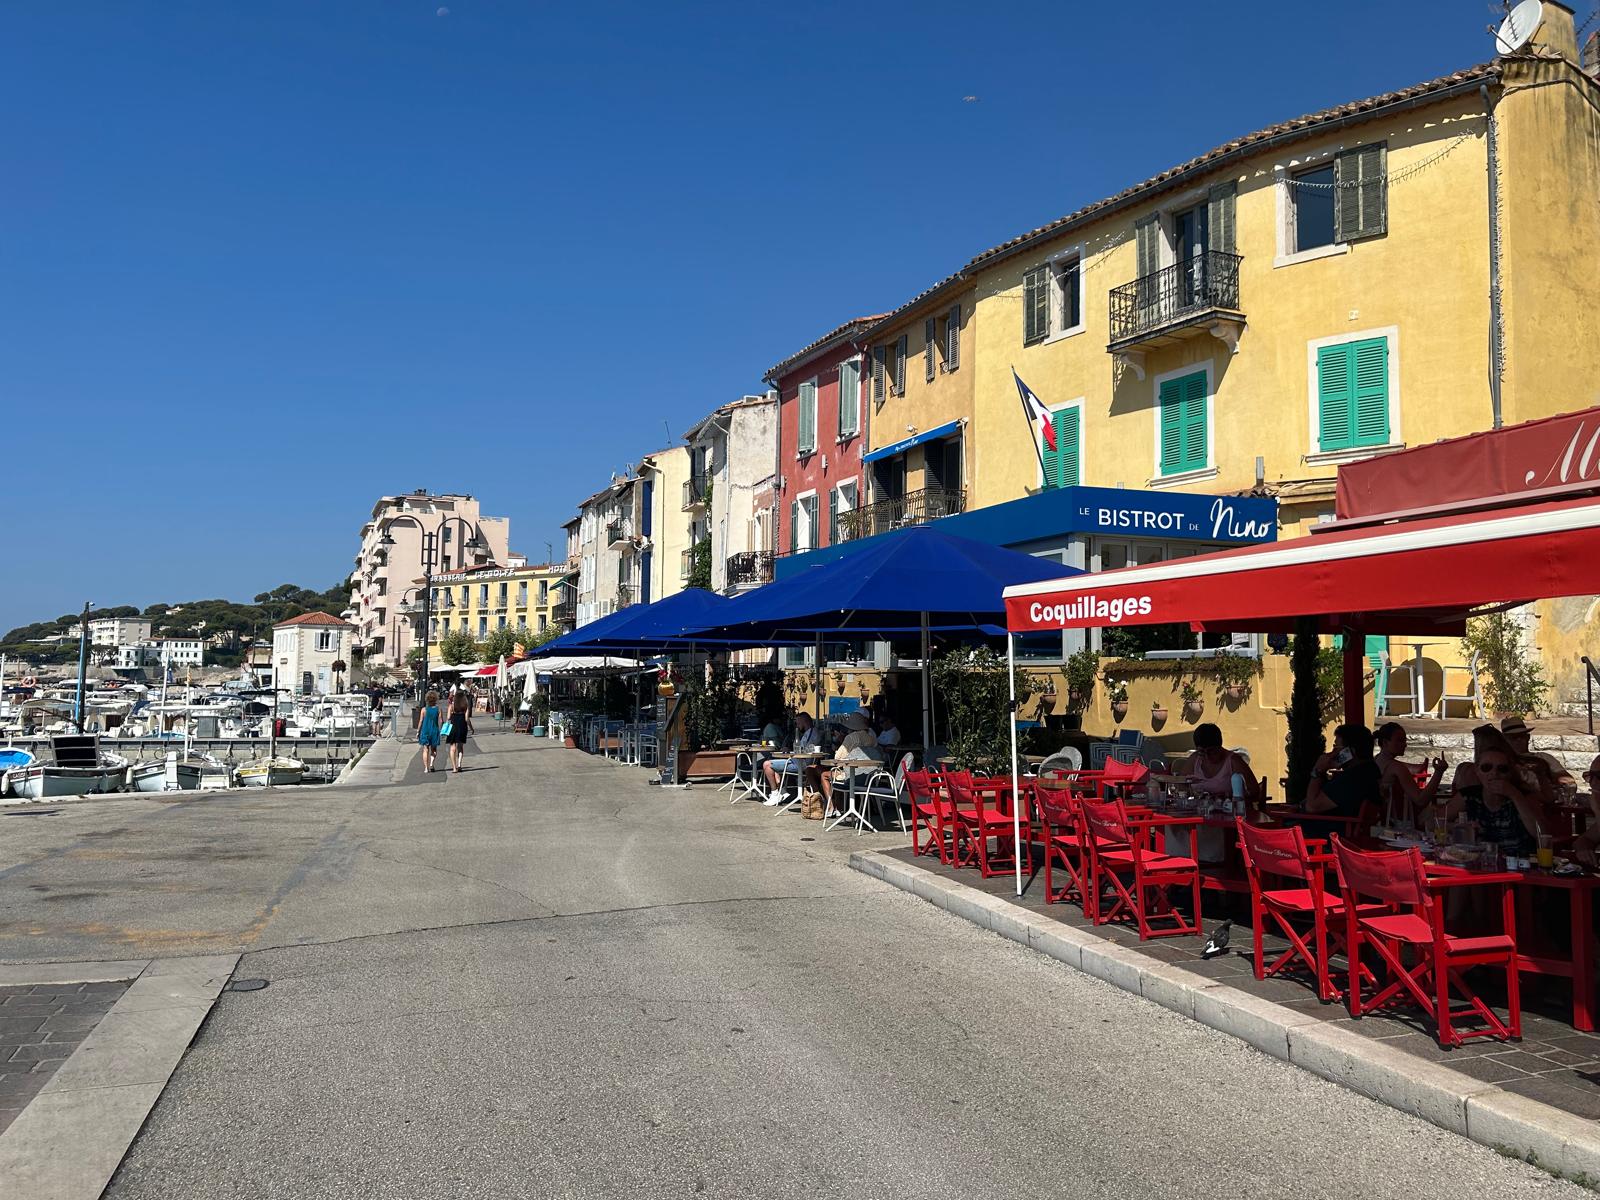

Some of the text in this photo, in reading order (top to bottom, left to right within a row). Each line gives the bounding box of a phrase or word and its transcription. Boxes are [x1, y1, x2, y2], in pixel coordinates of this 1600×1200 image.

[1525, 421, 1600, 487] M
[1079, 498, 1273, 538] LE BISTROT DE Nino
[1030, 595, 1152, 625] Coquillages
